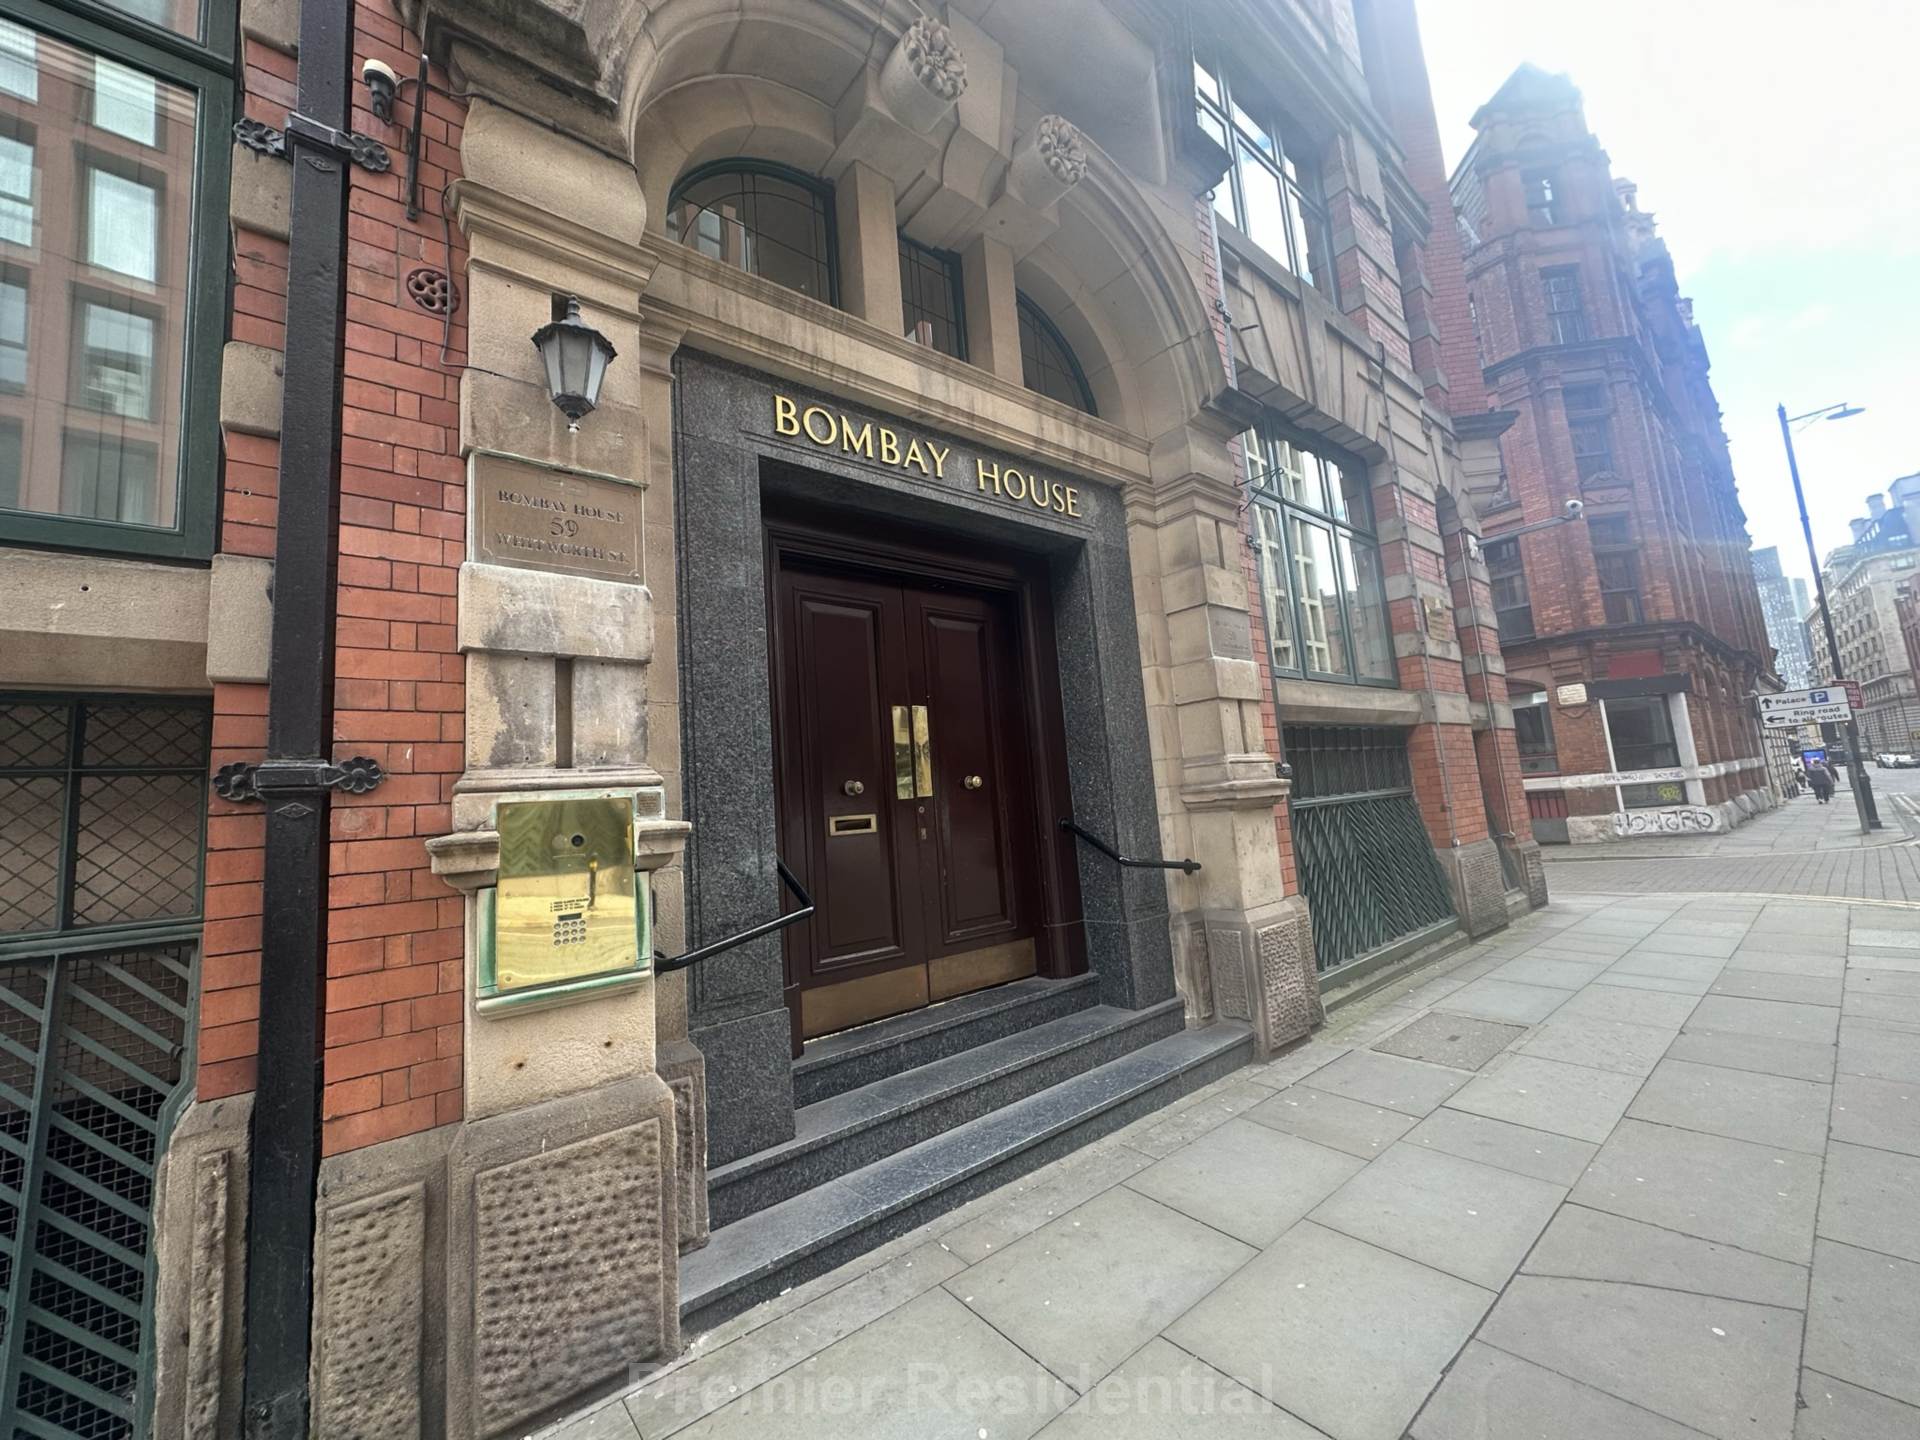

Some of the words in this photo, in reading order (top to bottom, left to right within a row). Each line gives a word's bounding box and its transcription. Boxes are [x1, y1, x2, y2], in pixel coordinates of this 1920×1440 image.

[774, 394, 950, 479] BOMBAY
[976, 458, 1082, 518] HOUSE
[497, 489, 567, 512] BOMBAY
[573, 504, 625, 524] HOUSE
[550, 517, 580, 538] 59
[495, 532, 604, 560] WHITWORTH
[1775, 697, 1807, 705] Palace
[1793, 708, 1815, 717] Ring
[1818, 706, 1841, 714] road
[1817, 713, 1849, 721] routes
